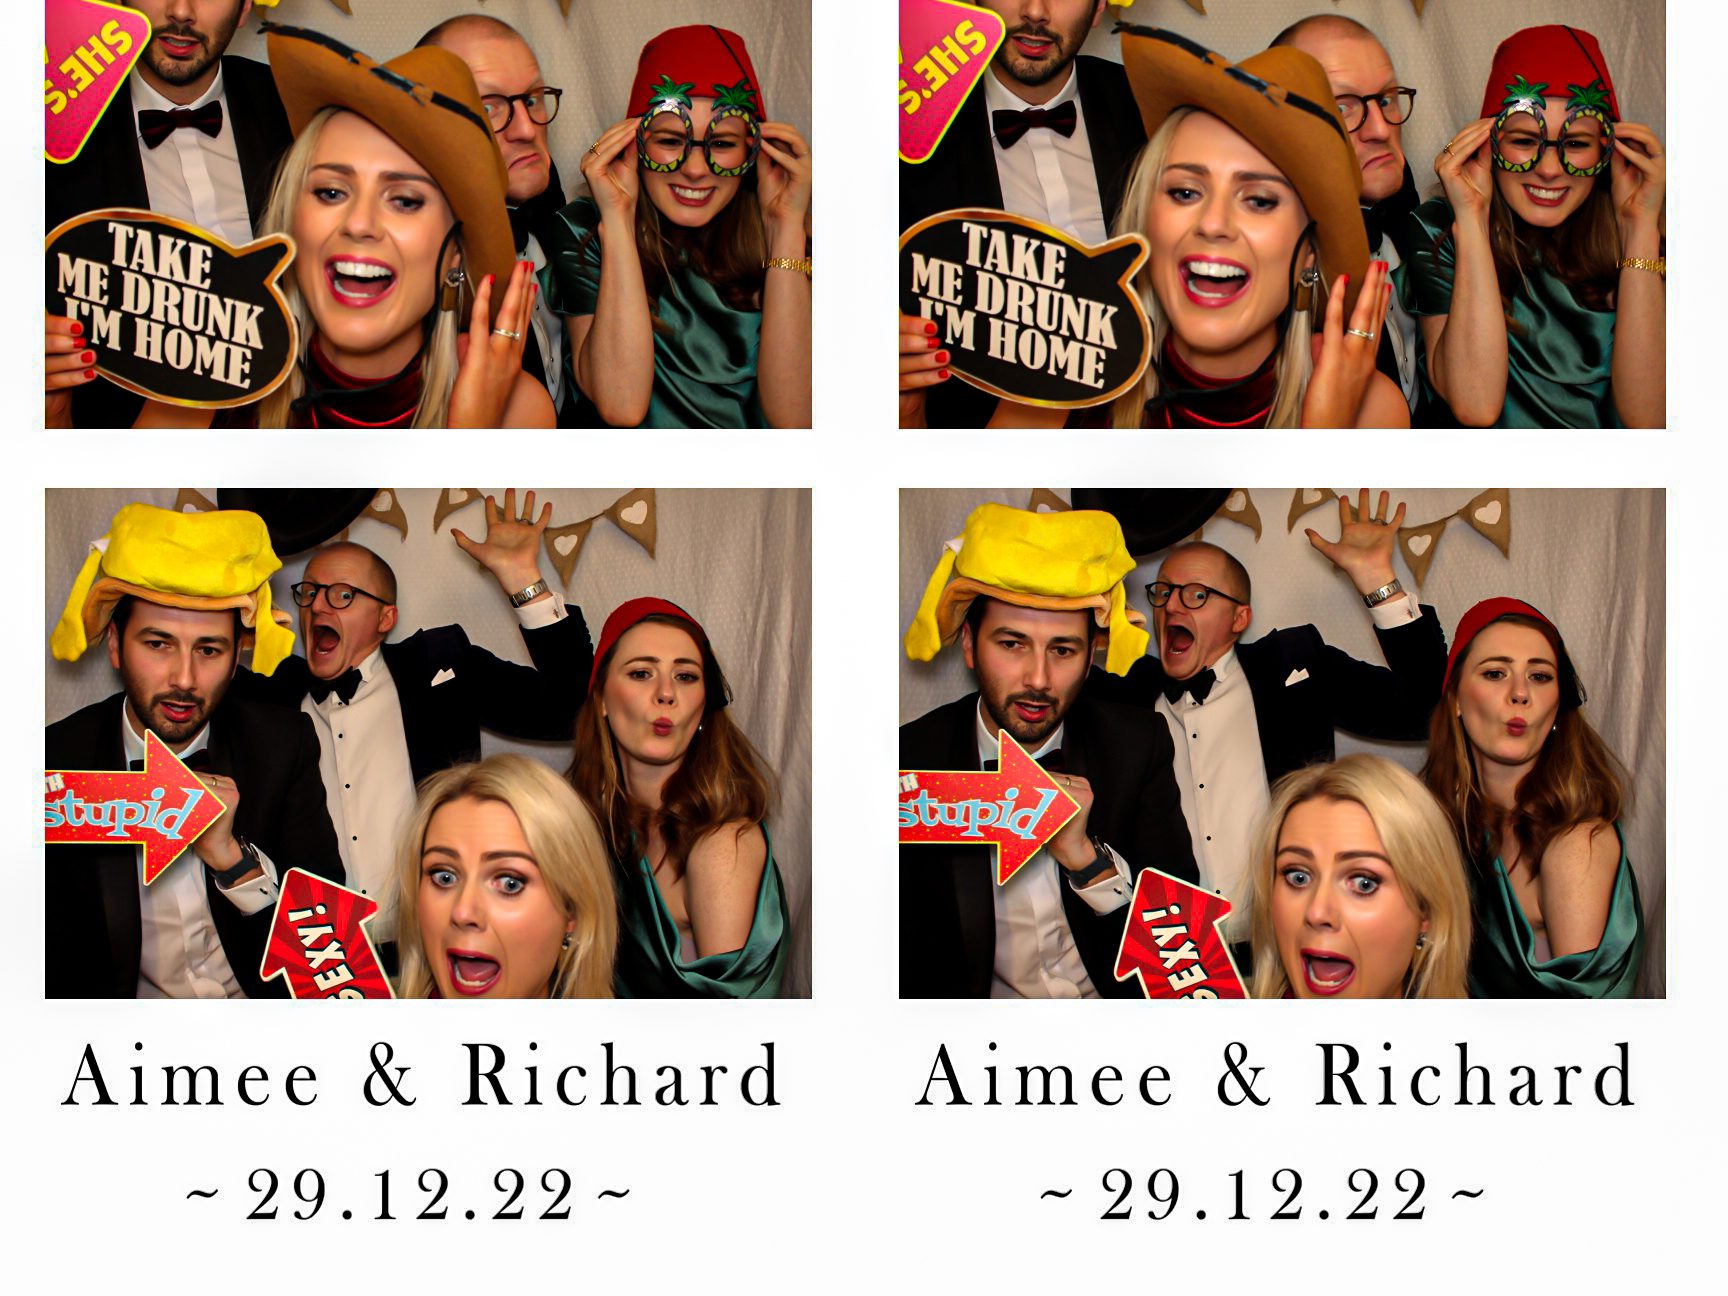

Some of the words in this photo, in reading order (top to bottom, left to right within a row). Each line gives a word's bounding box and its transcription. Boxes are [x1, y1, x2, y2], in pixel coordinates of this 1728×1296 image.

[108, 222, 213, 290] TAKE
[962, 222, 1067, 290] TAKE
[57, 253, 109, 305] ME
[121, 270, 264, 350] DRUNK
[911, 253, 963, 305] ME
[975, 270, 1118, 350] DRUNK
[134, 317, 252, 389] HOME
[988, 317, 1106, 389] HOME
